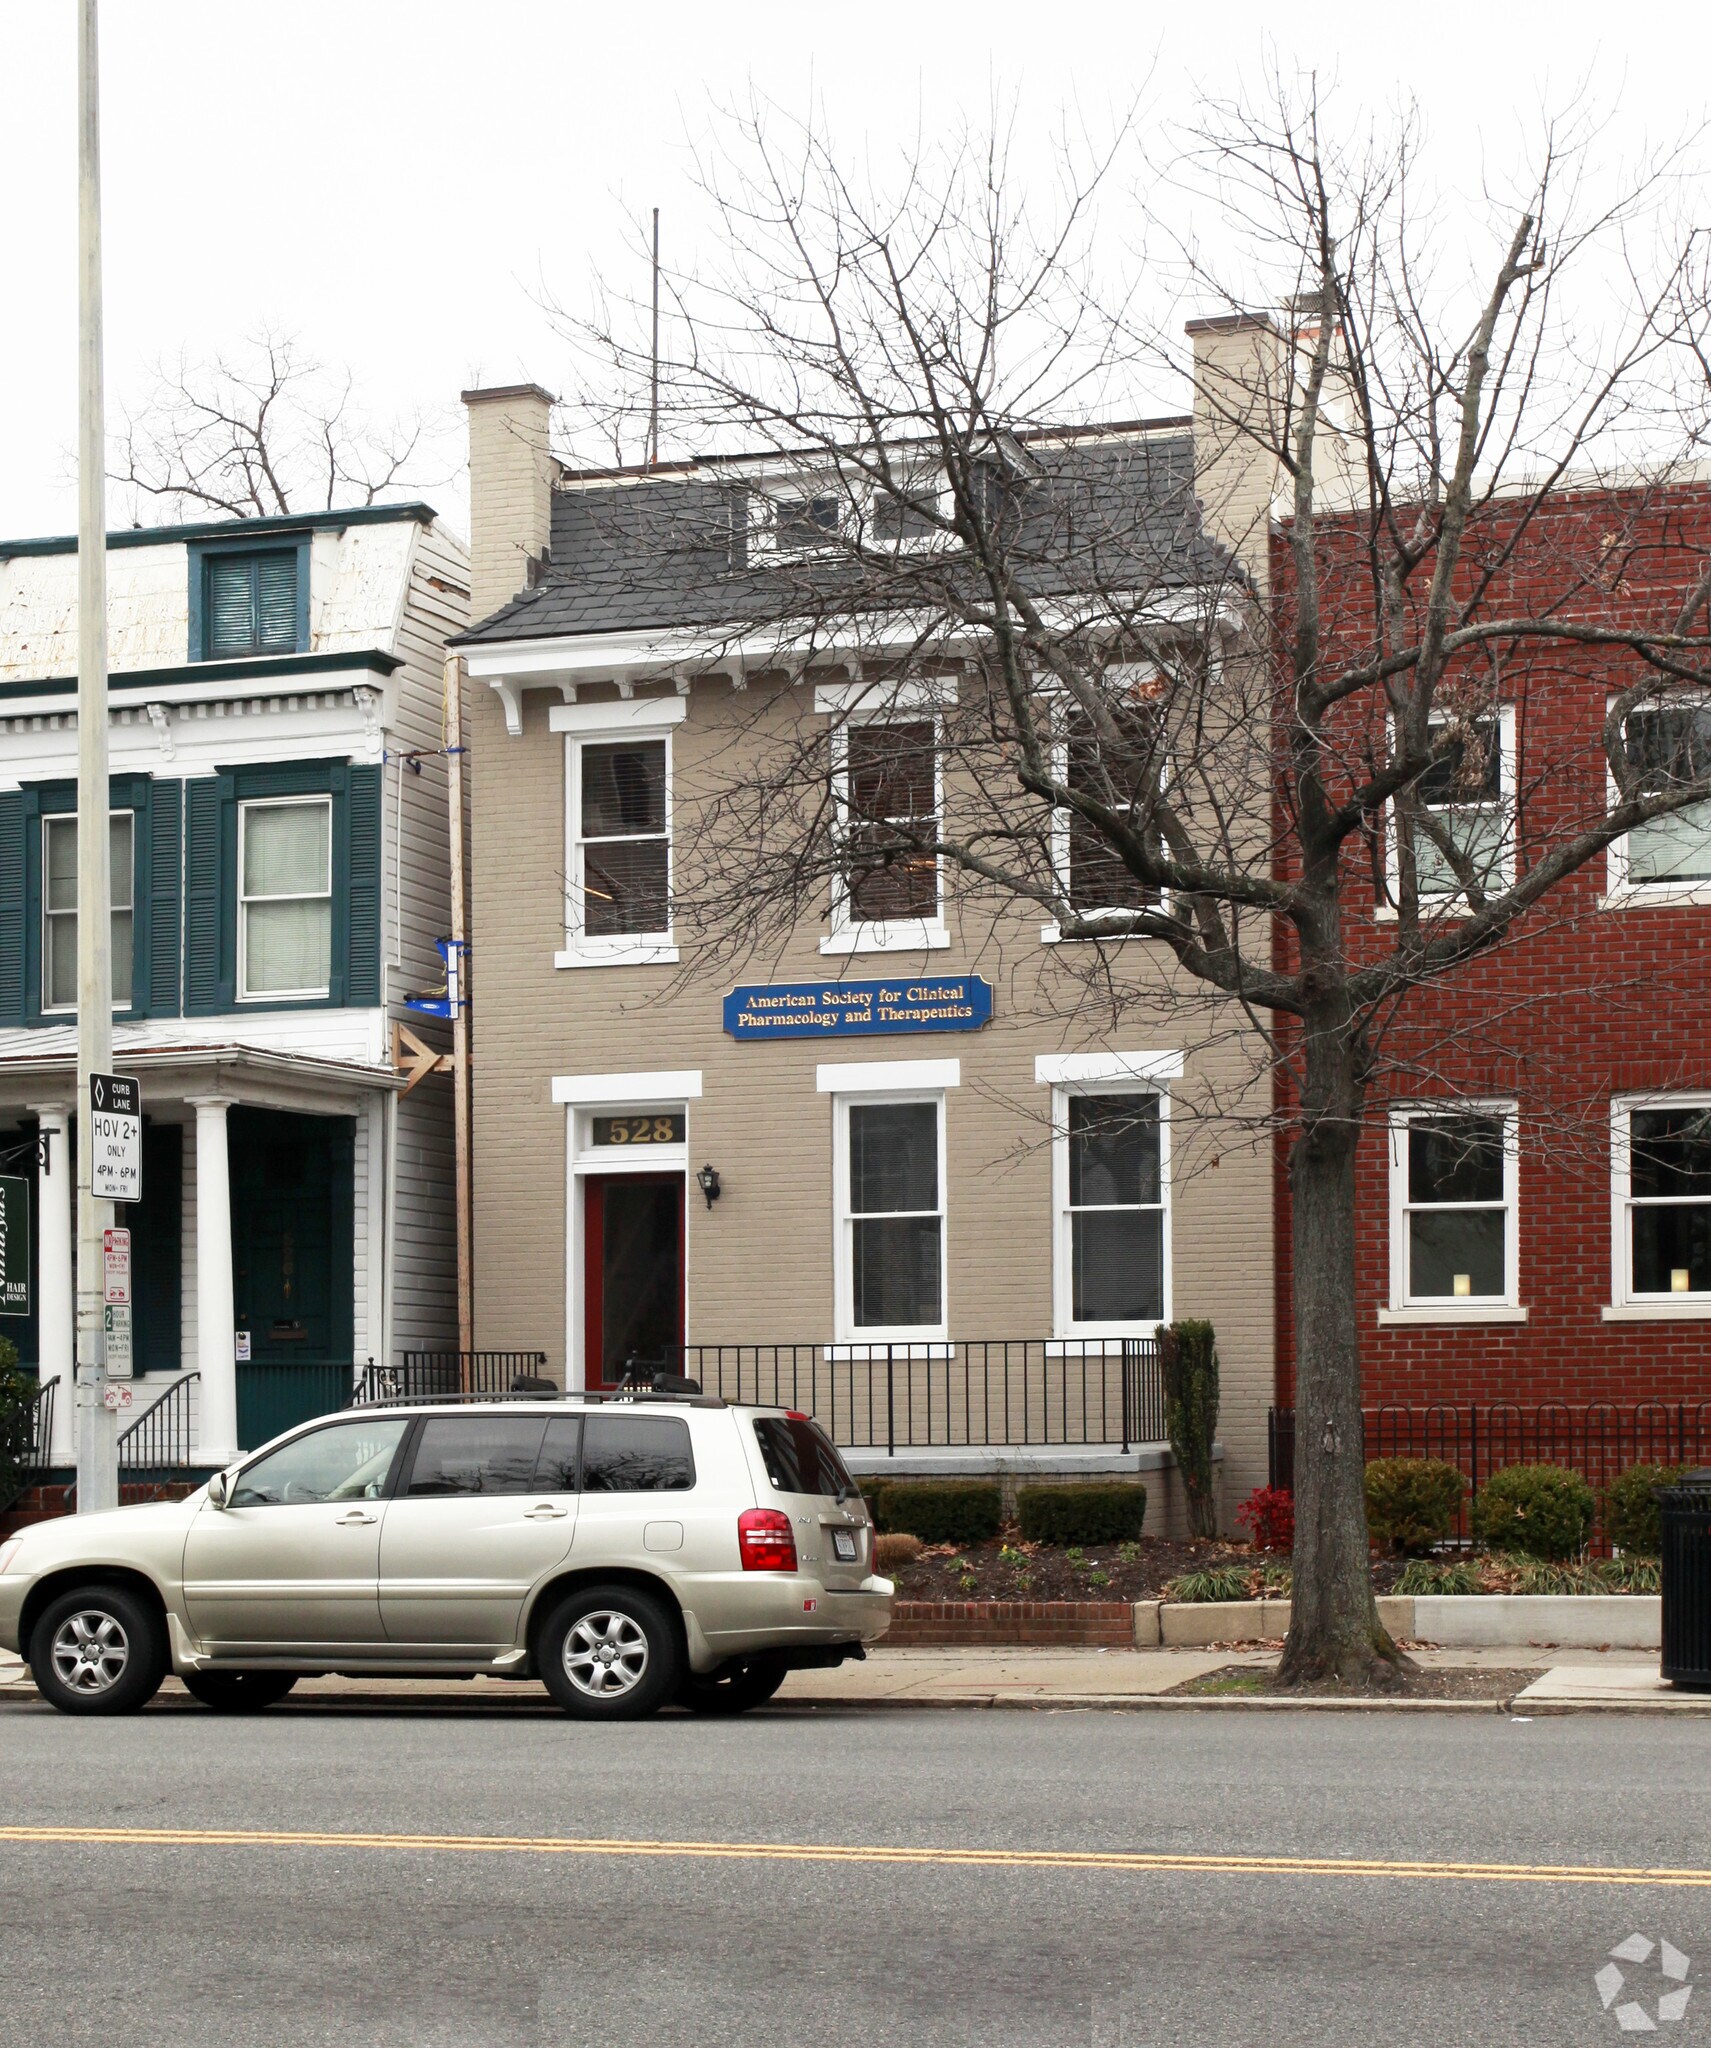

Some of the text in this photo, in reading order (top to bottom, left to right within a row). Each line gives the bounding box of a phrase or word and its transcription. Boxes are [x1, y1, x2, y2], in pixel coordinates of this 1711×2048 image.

[746, 985, 964, 1008] American Society for Clinical
[738, 1004, 972, 1027] Pharmacology and Therapeutics
[112, 1083, 130, 1095] CURB
[113, 1098, 131, 1110] LANE
[95, 1118, 138, 1139] HOV 2+
[610, 1118, 673, 1142] 528
[107, 1145, 126, 1157] ONLY
[7, 1282, 26, 1293] HAIR
[7, 1293, 26, 1302] DESIGN
[106, 1310, 112, 1328] 2
